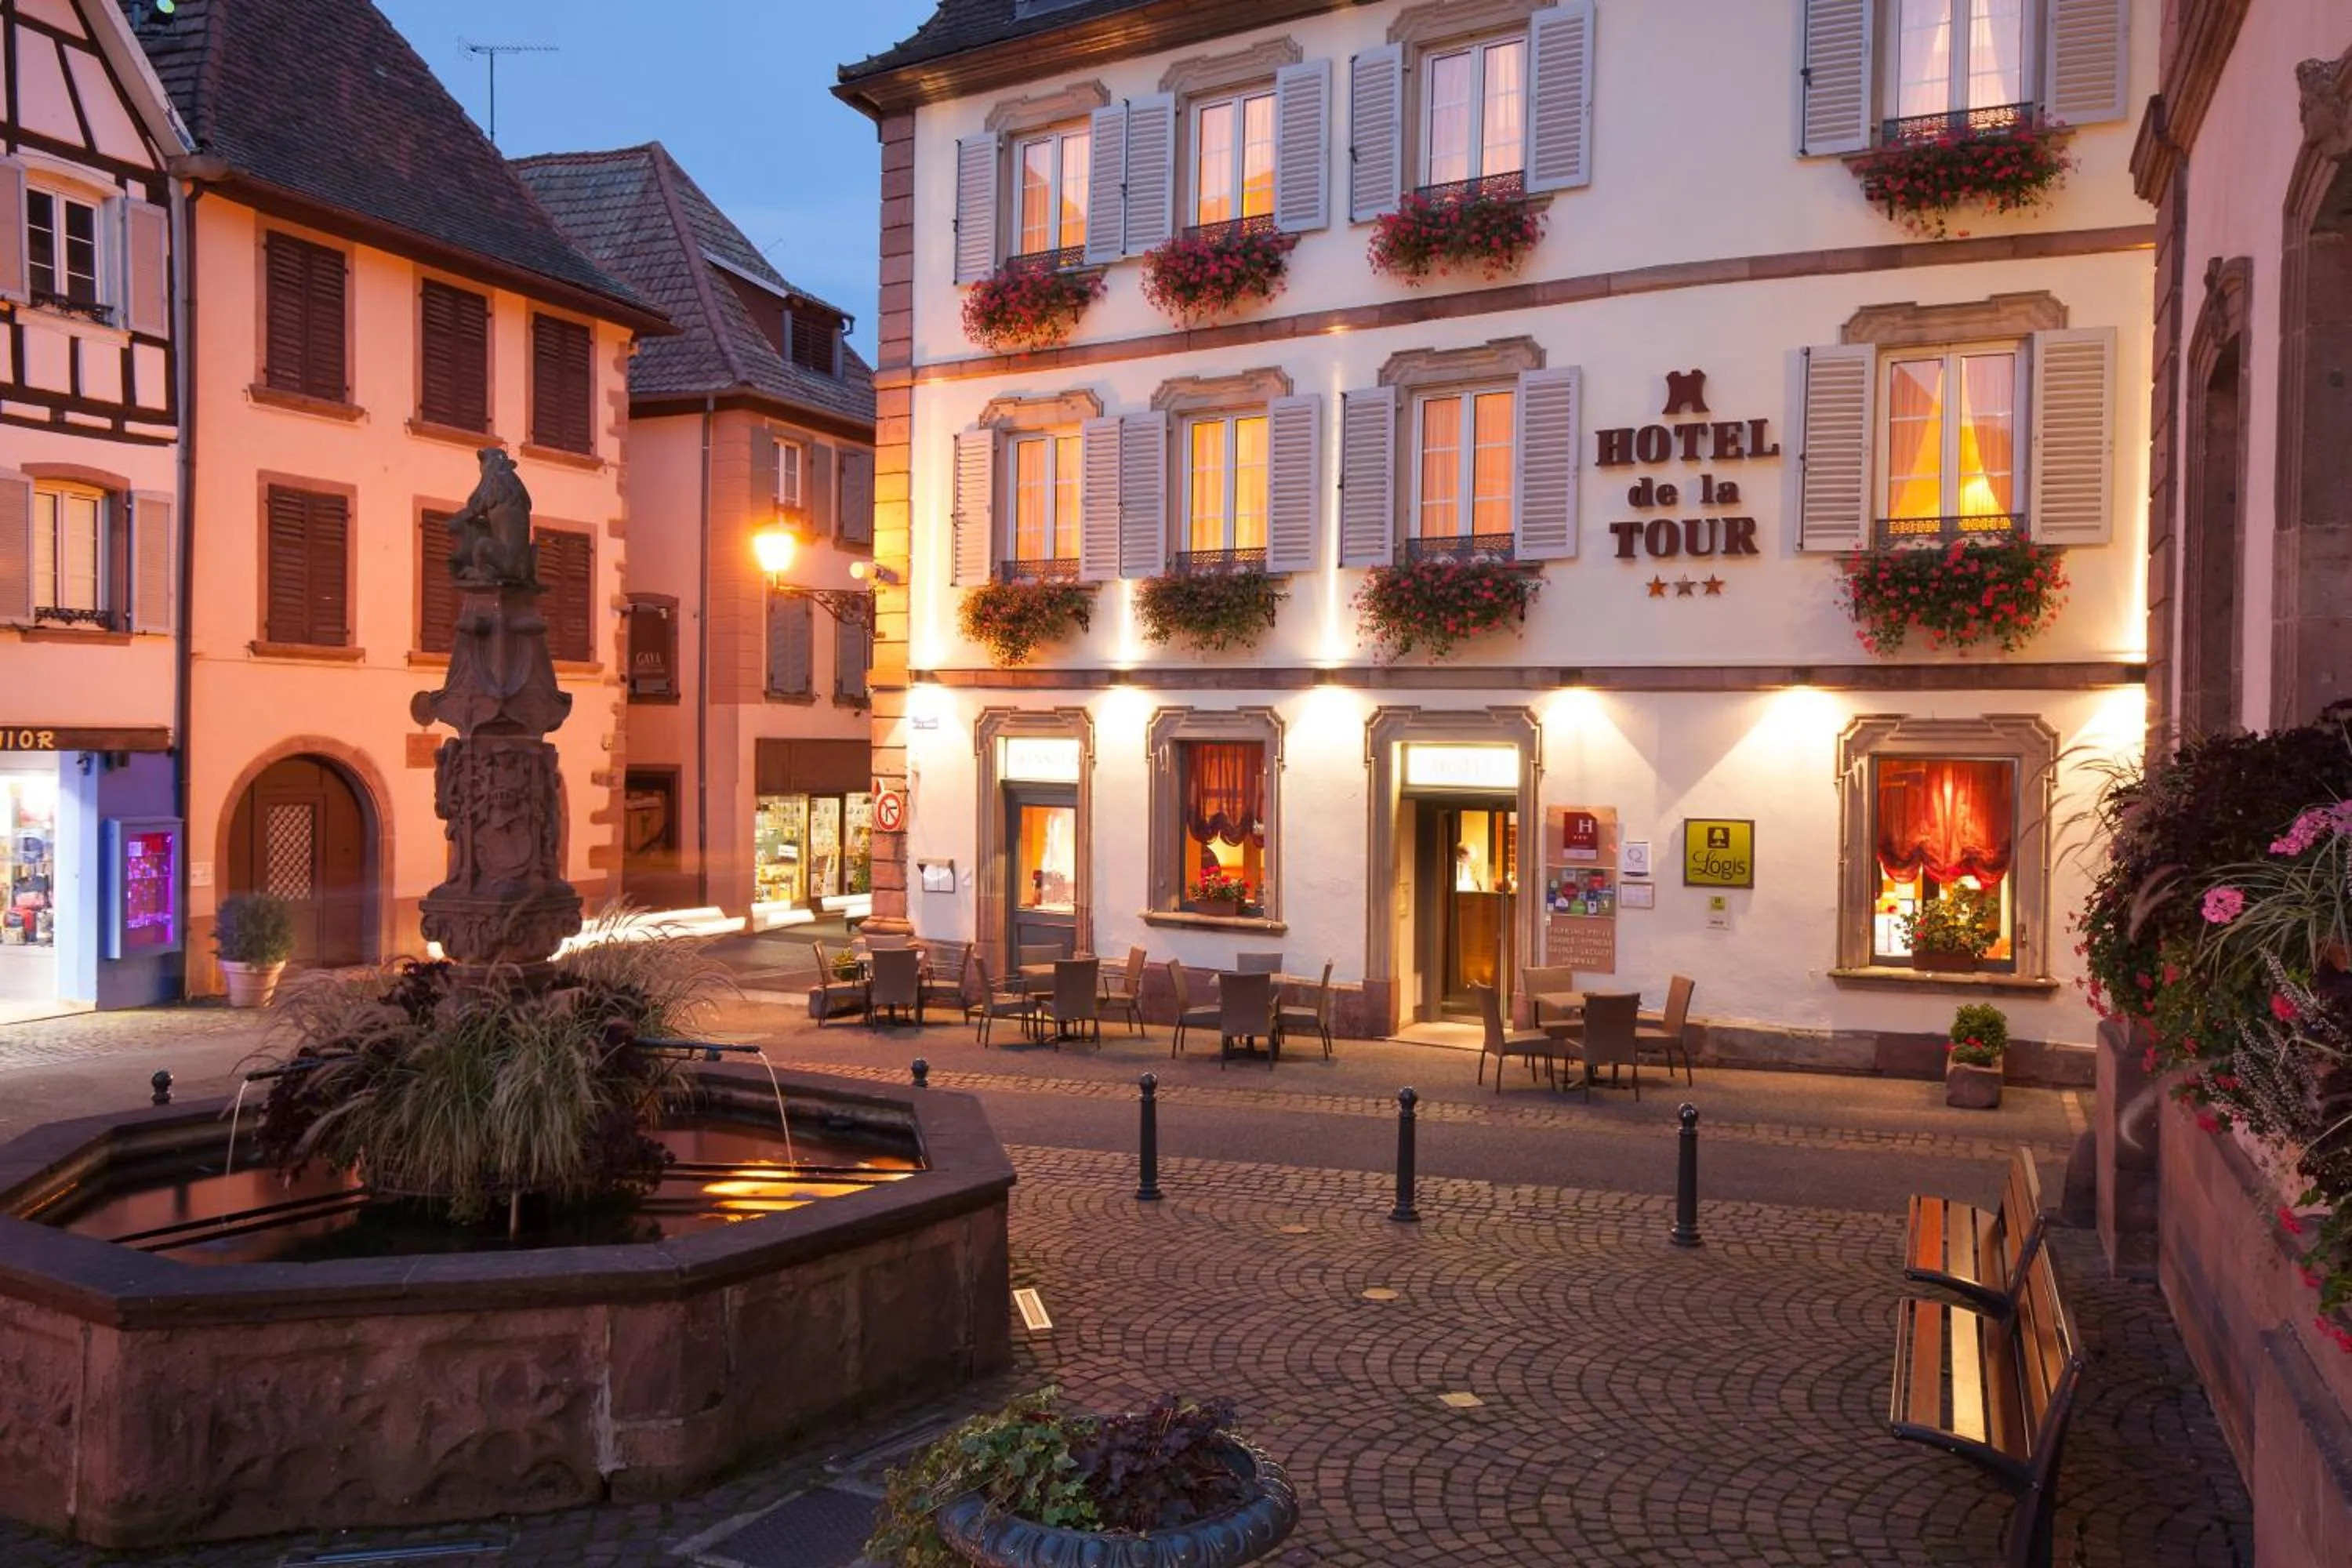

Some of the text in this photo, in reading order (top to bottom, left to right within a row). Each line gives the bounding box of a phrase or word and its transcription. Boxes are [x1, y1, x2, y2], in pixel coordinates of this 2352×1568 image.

[1595, 419, 1780, 466] HOTEL
[1628, 474, 1741, 507] de la
[1610, 517, 1760, 558] TOUR
[1578, 819, 1592, 833] H
[1692, 850, 1746, 880] Logis
